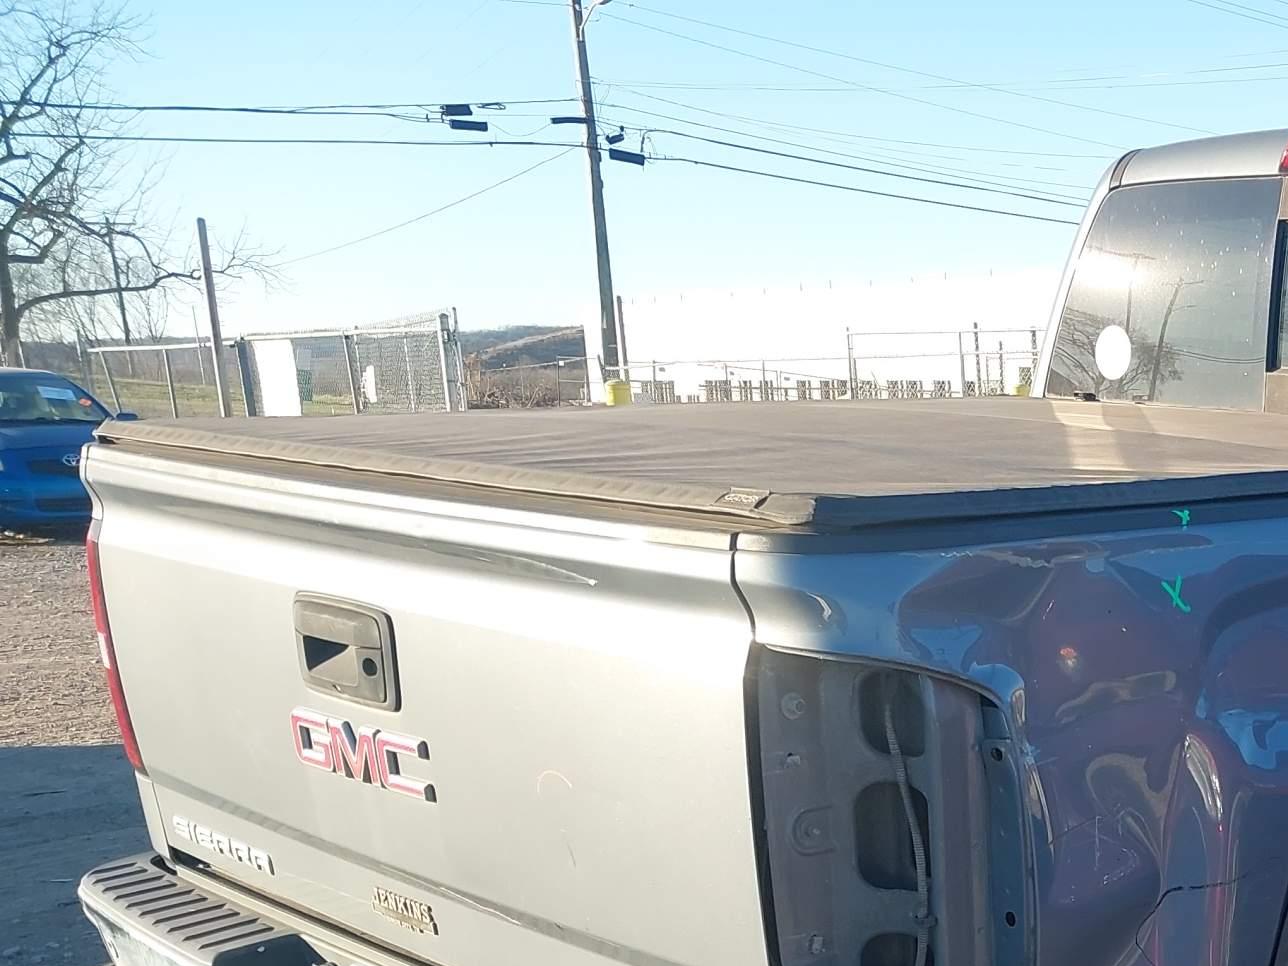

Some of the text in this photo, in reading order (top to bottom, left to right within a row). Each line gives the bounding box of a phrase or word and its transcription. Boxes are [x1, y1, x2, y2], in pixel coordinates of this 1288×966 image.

[290, 697, 438, 804] GMC
[173, 815, 276, 877] SIERRA
[372, 886, 431, 924] JENKINS
